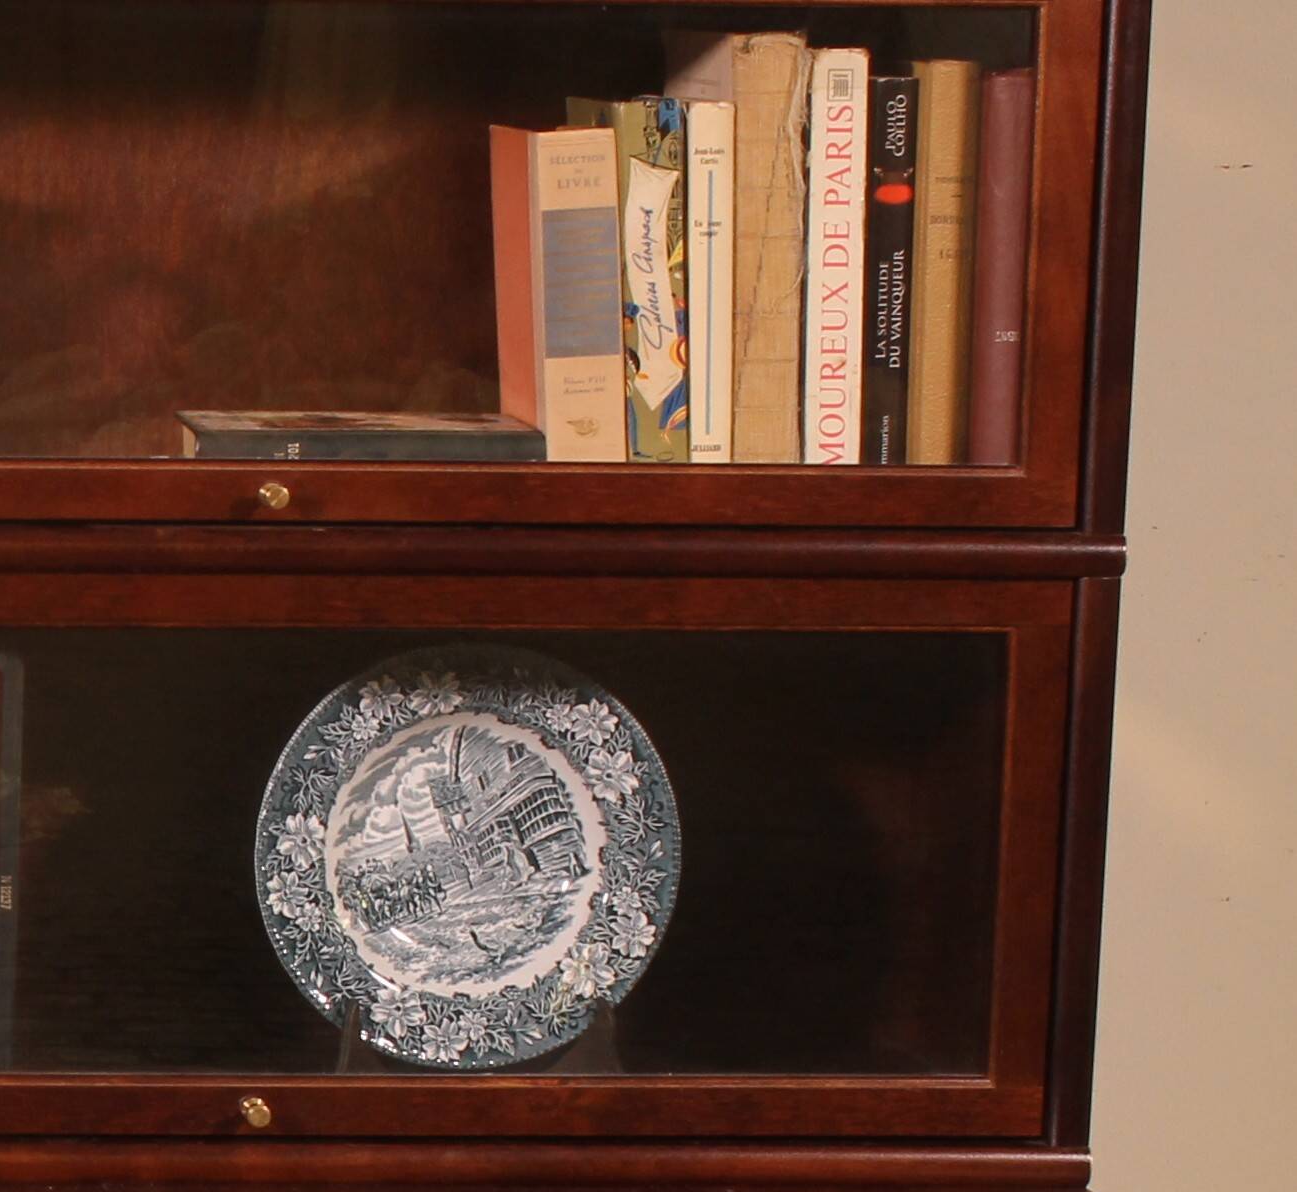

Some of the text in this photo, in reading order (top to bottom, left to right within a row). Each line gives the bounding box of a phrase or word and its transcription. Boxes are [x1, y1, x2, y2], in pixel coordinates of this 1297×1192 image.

[824, 104, 854, 206] PARIS
[884, 101, 897, 149] PAULO
[892, 94, 907, 157] COELHO
[557, 178, 602, 189] LIVRE
[822, 220, 850, 271] DE
[875, 261, 889, 359] LA SOLITUDE
[889, 249, 905, 368] DU VAINQUEUR
